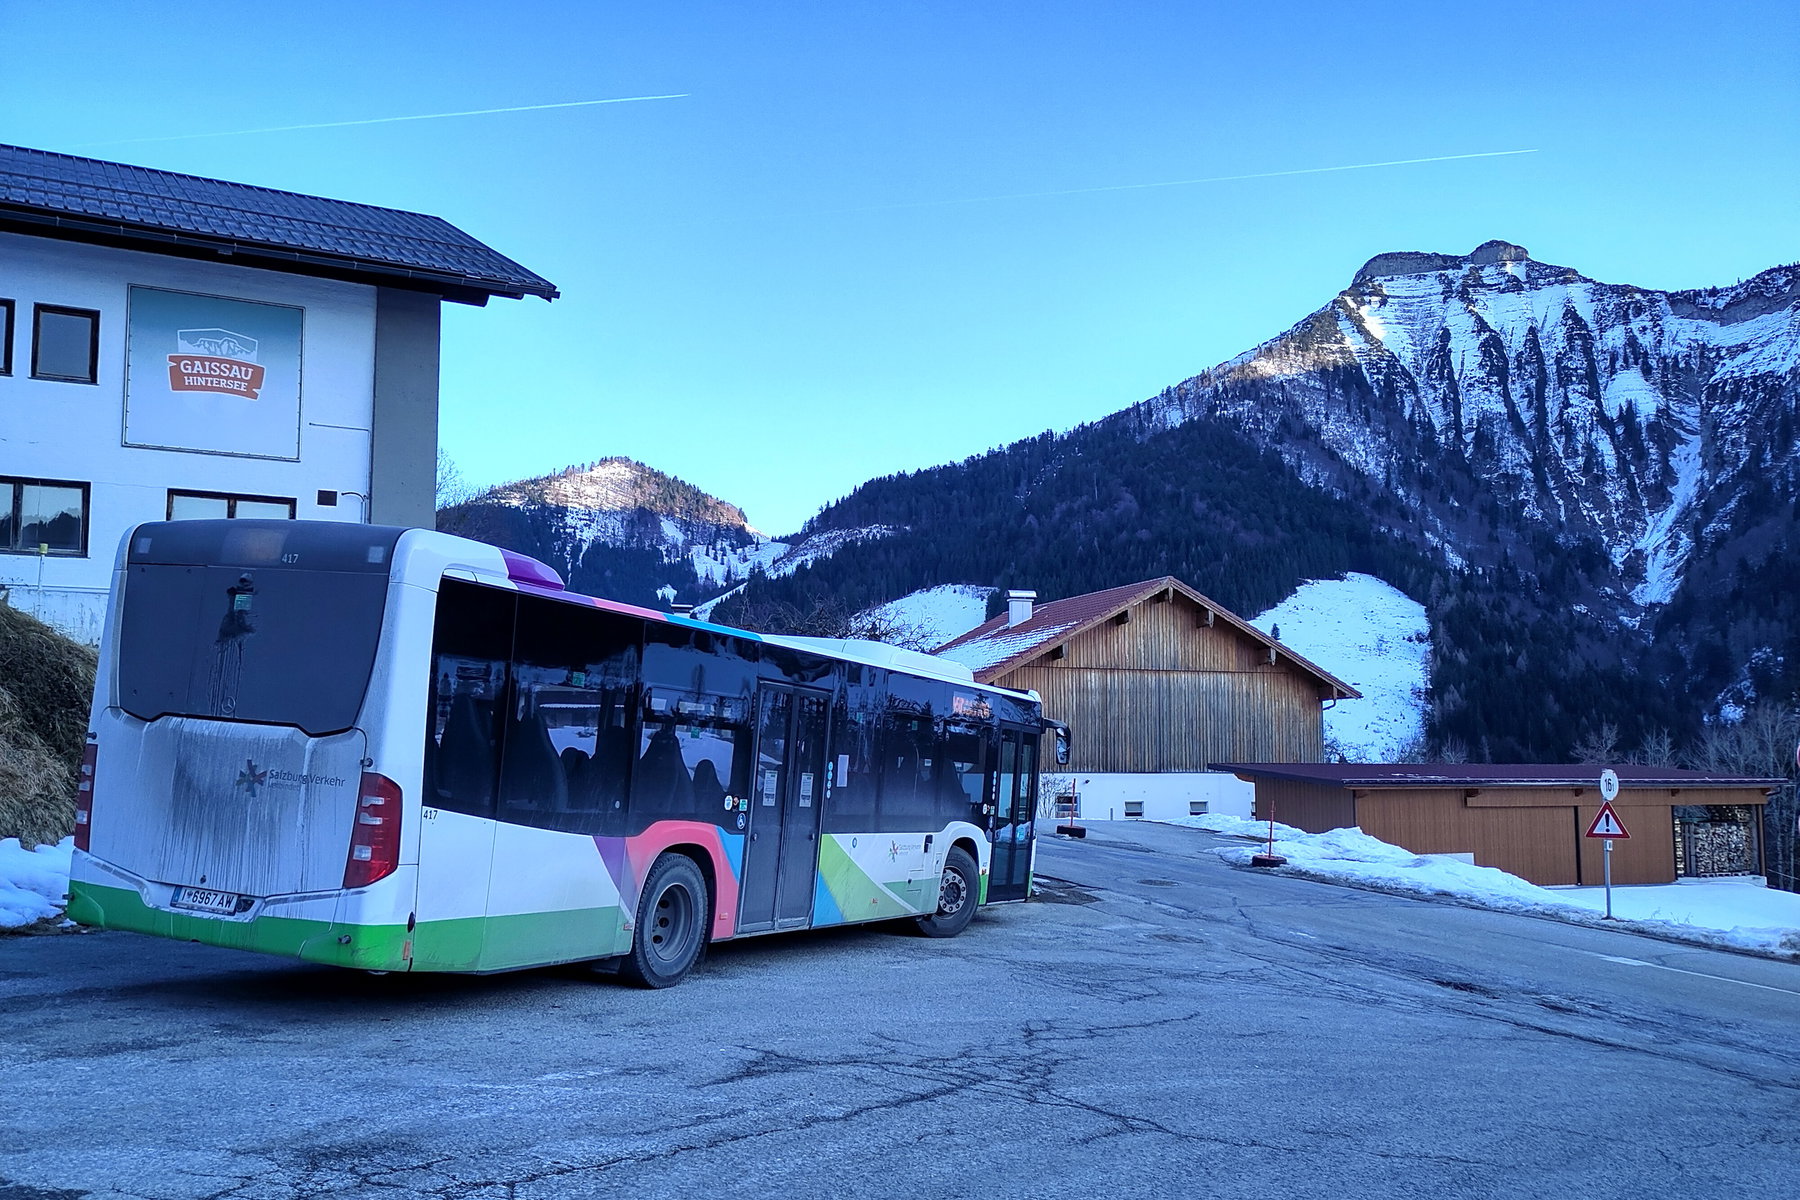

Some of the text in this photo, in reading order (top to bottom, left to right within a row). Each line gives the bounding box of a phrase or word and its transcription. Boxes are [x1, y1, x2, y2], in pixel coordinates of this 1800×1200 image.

[180, 360, 254, 380] GAISSAU
[184, 376, 248, 391] HINTERSEE
[281, 553, 299, 564] 417
[269, 769, 309, 785] Salzburg
[309, 774, 346, 787] Verkehr
[423, 810, 438, 820] 417
